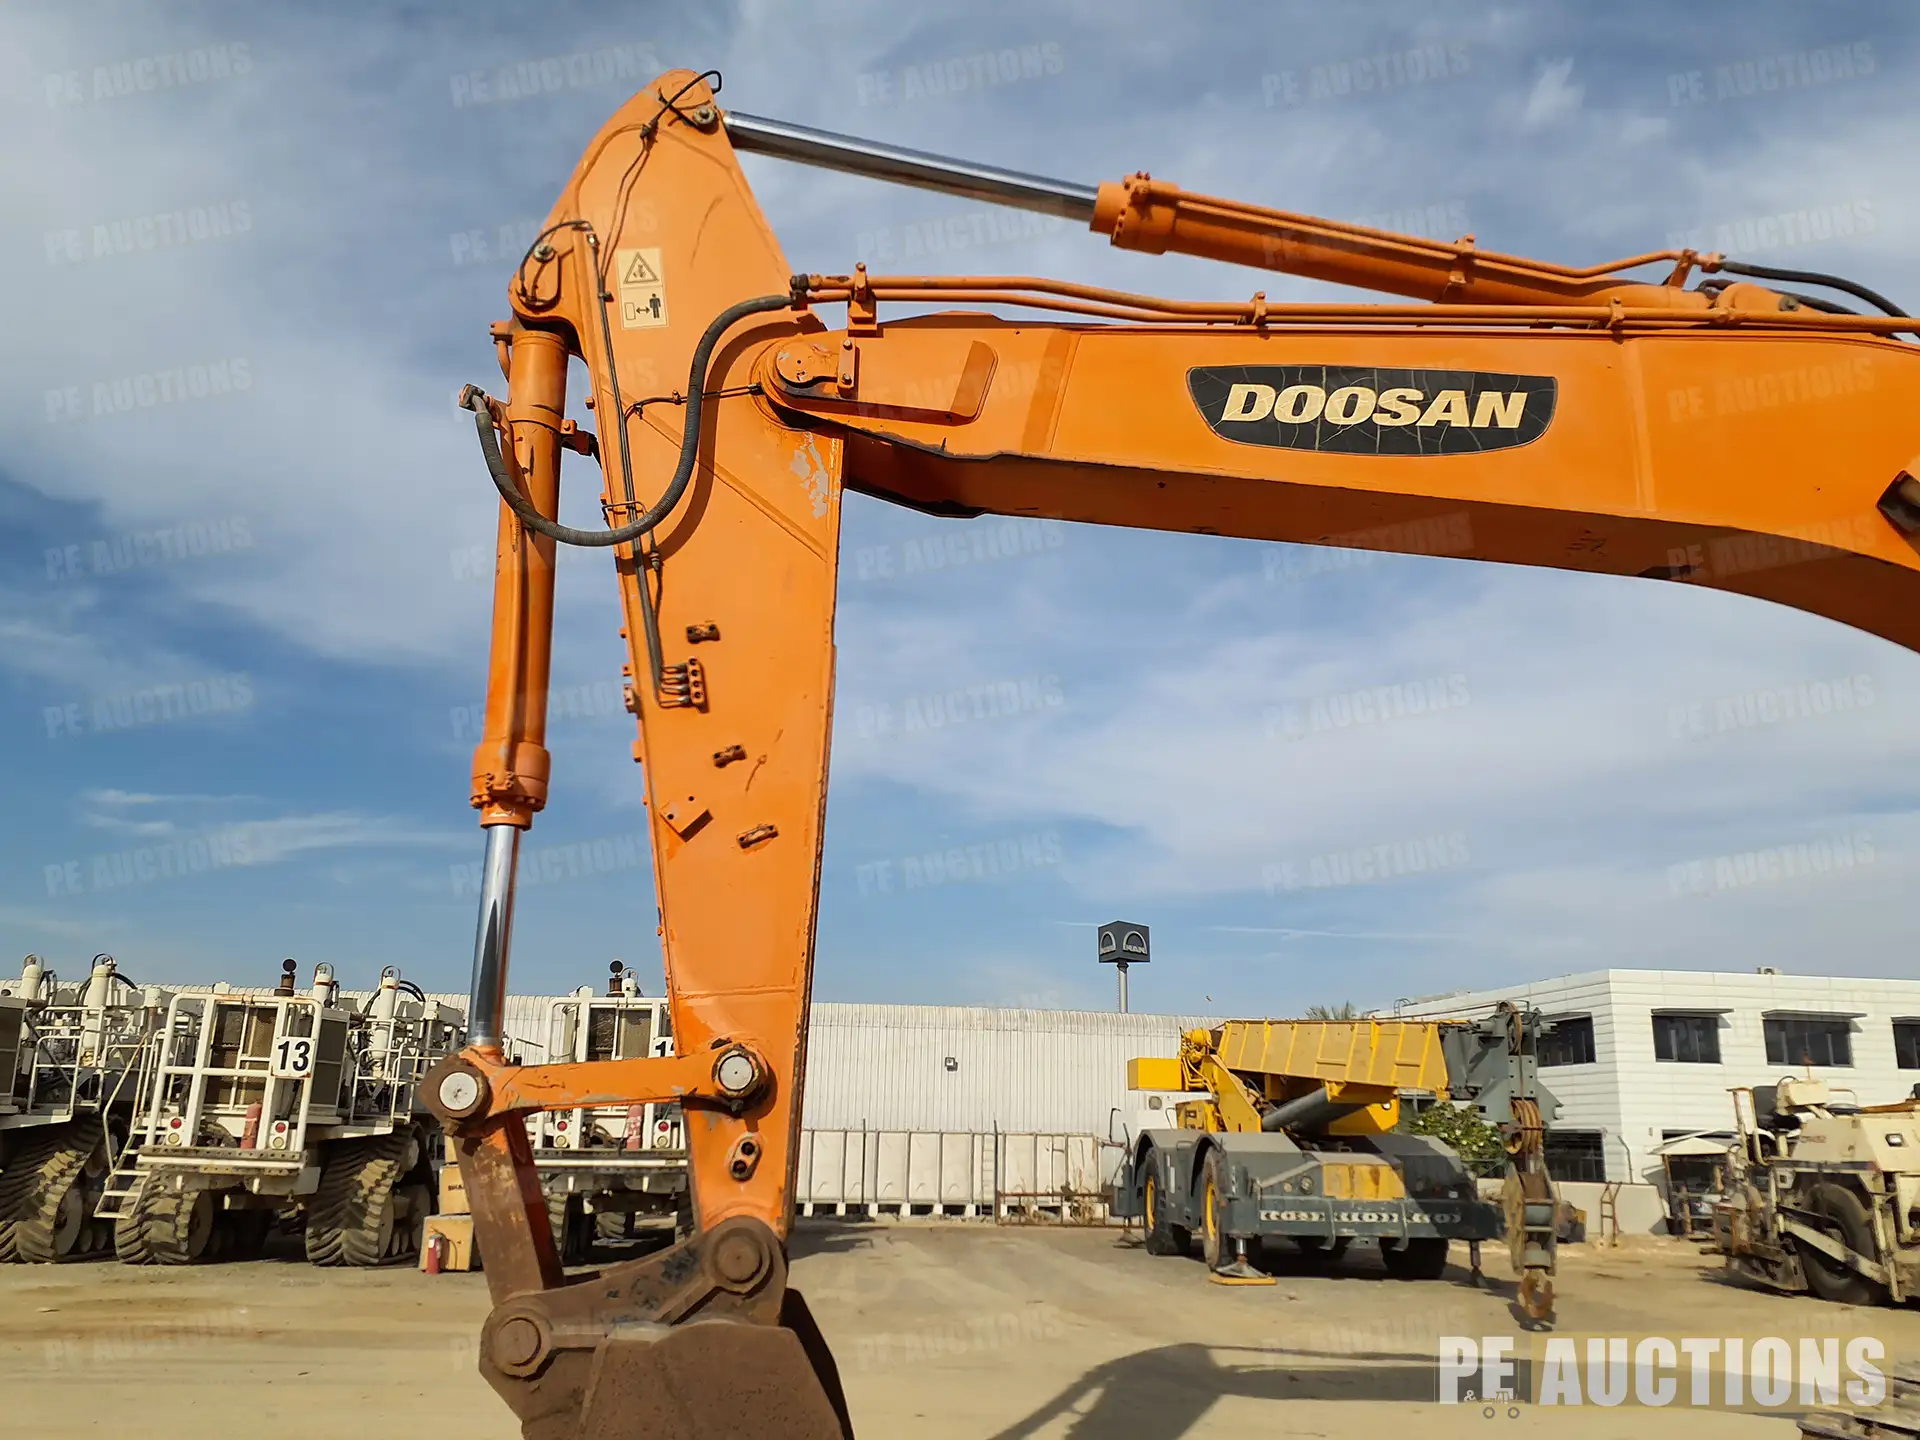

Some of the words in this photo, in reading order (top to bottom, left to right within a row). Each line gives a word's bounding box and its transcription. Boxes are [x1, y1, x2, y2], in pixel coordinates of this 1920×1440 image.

[1222, 384, 1528, 428] DOOSAN
[278, 1041, 310, 1071] 13
[655, 1041, 674, 1057] 1
